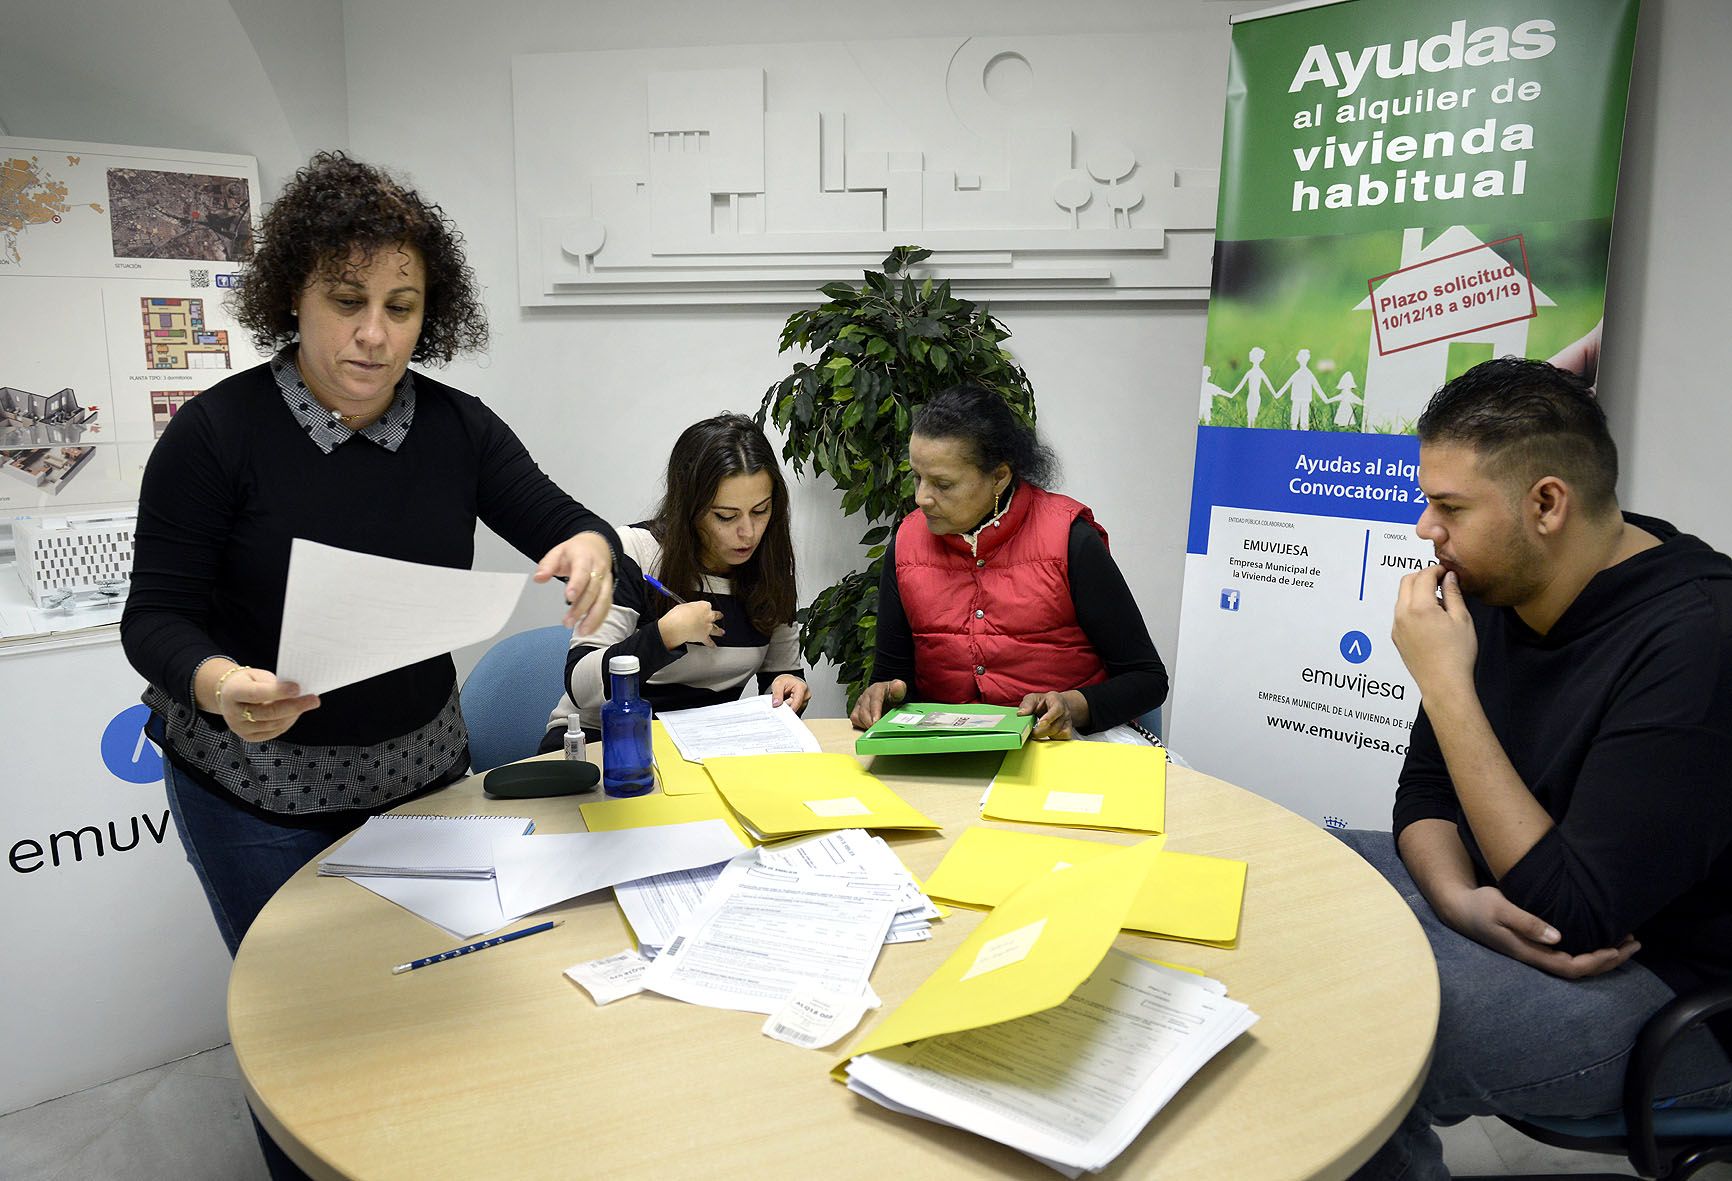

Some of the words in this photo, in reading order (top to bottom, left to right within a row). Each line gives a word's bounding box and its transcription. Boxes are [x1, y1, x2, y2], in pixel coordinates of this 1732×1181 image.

[1288, 19, 1556, 97] Ayudas
[1293, 104, 1322, 129] al
[1336, 86, 1476, 124] alquiler
[1491, 78, 1541, 104] de
[1292, 118, 1534, 171] vivienda
[1292, 160, 1527, 211] habitual
[1380, 289, 1428, 312] Plazo
[1433, 262, 1515, 297] solicitud
[1382, 304, 1443, 330] 10/12/18
[1449, 301, 1458, 312] a
[1462, 282, 1521, 309] 9/01/19
[1295, 454, 1361, 475] Ayudas
[1365, 459, 1382, 475] al
[1289, 478, 1408, 502] Convocatoria
[1413, 487, 1430, 504] 2
[1243, 539, 1308, 556] EMUVIJESA
[1380, 555, 1422, 570] JUNTA
[1229, 557, 1263, 568] Empresa
[1265, 561, 1307, 575] Municipal
[1309, 568, 1321, 576] de
[1241, 571, 1277, 583] Vivienda
[1279, 576, 1290, 585] de
[1291, 578, 1314, 588] Jerez
[1302, 668, 1405, 700] emuvijesa
[1258, 691, 1290, 705] EMPRESA
[1291, 698, 1330, 714] MUNICIPAL
[1332, 706, 1342, 716] DE
[1344, 708, 1353, 718] LA
[1355, 710, 1390, 725] VIVIENDA
[1392, 718, 1403, 728] DE
[8, 809, 170, 873] emuv
